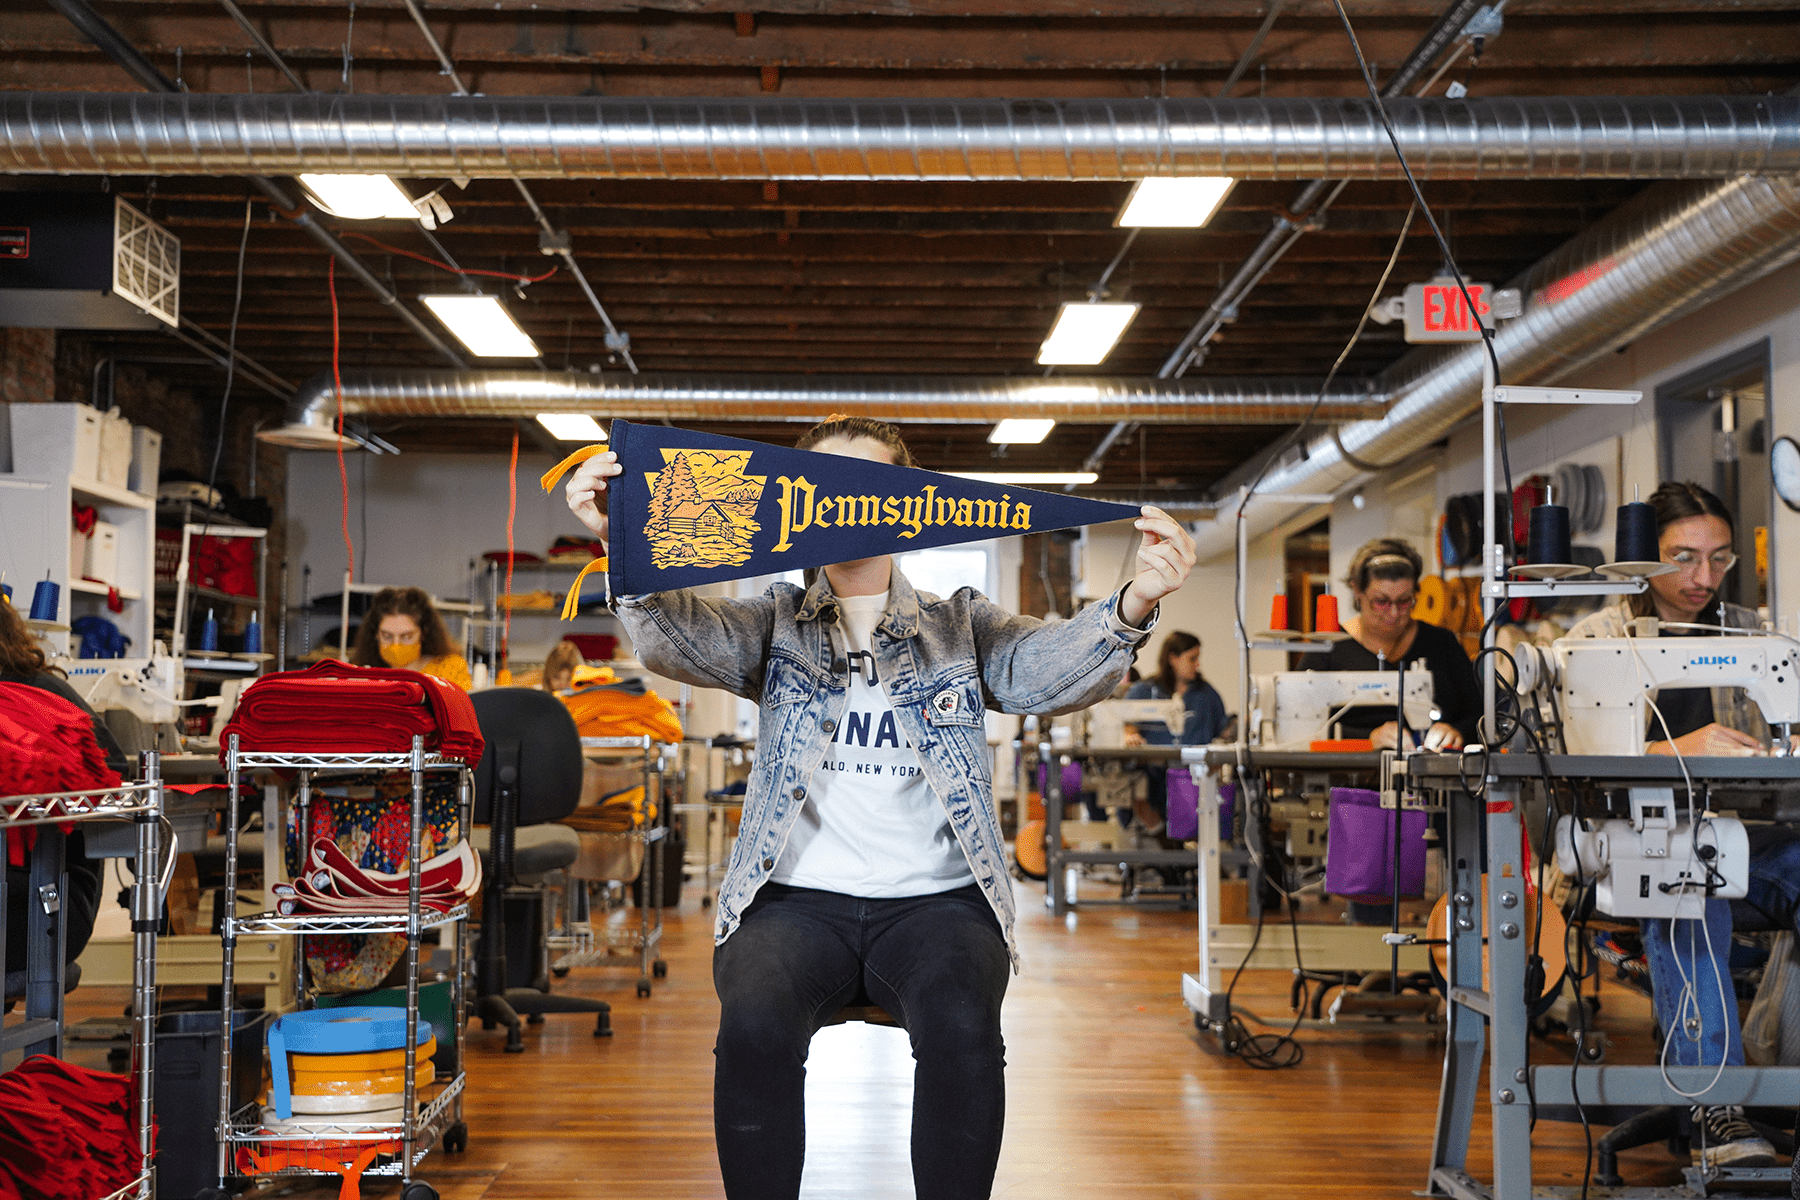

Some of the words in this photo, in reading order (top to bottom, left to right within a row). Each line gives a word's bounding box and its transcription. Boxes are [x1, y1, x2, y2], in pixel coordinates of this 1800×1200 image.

[1423, 285, 1484, 331] EXIT
[771, 475, 1032, 552] Pennsylvania
[1690, 656, 1737, 665] JUKI
[856, 763, 882, 775] NEW
